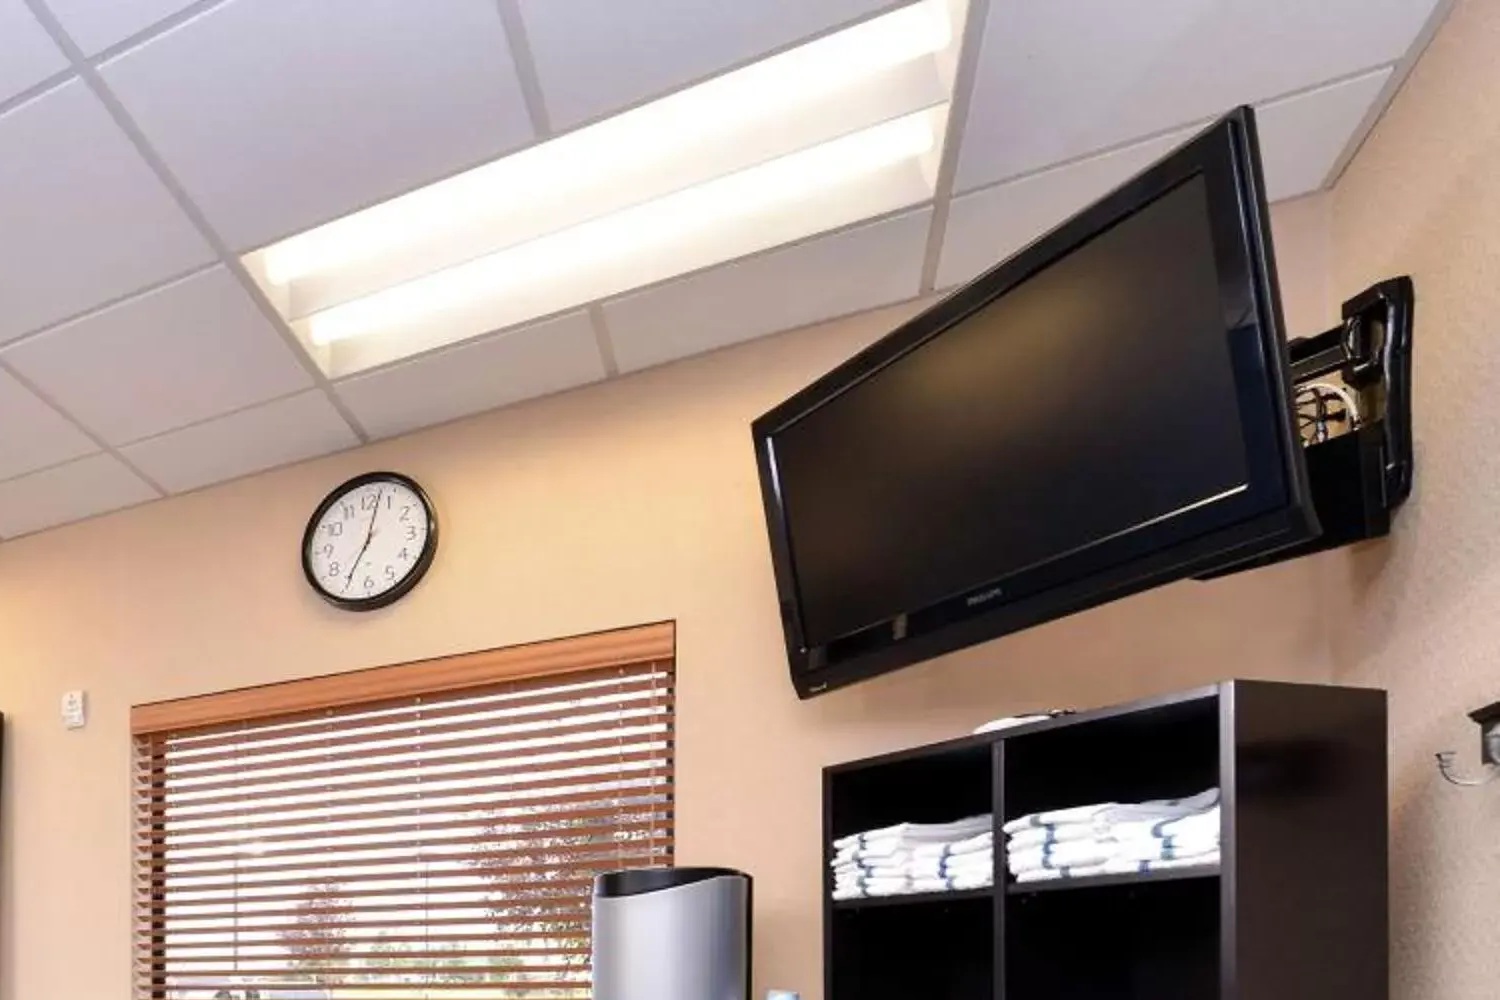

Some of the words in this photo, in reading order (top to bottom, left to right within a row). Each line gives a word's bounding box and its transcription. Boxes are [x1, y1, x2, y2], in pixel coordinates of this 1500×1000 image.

[361, 494, 378, 510] 12
[343, 504, 355, 519] 11
[399, 506, 410, 522] 2
[328, 521, 343, 536] 10
[406, 526, 417, 541] 3
[323, 543, 334, 558] 9
[398, 547, 409, 561] 4
[328, 561, 341, 577] 8
[385, 565, 396, 580] 5
[363, 575, 375, 589] 6
